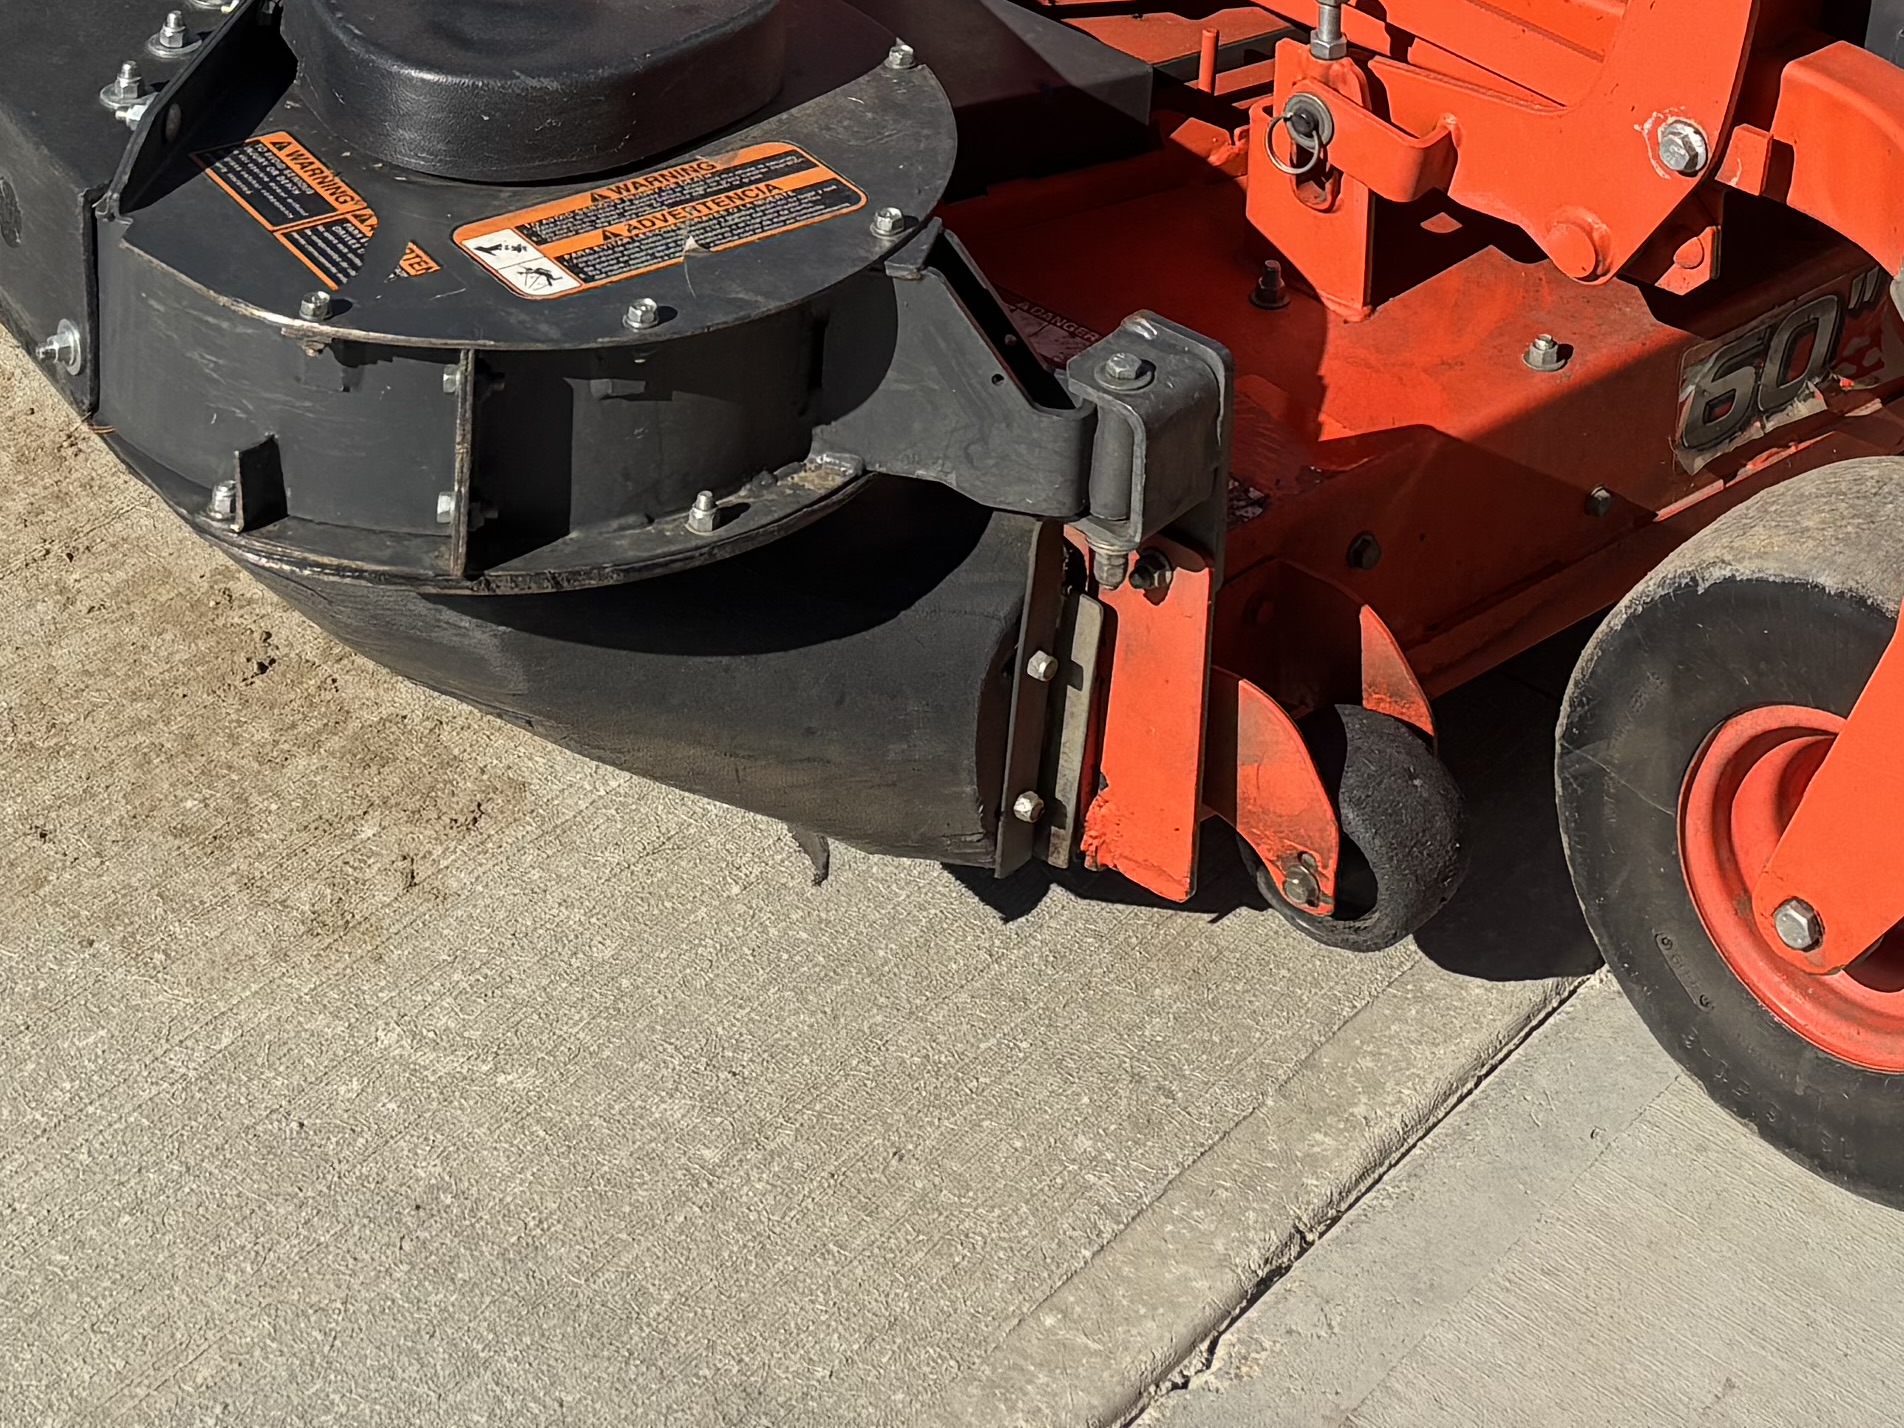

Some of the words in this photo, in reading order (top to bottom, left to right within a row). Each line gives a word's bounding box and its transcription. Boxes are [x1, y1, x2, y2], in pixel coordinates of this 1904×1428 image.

[285, 149, 355, 205] WARNING
[609, 160, 717, 197] WARNING
[625, 183, 783, 234] ADVERTENCIA
[1029, 306, 1102, 342] DANGER
